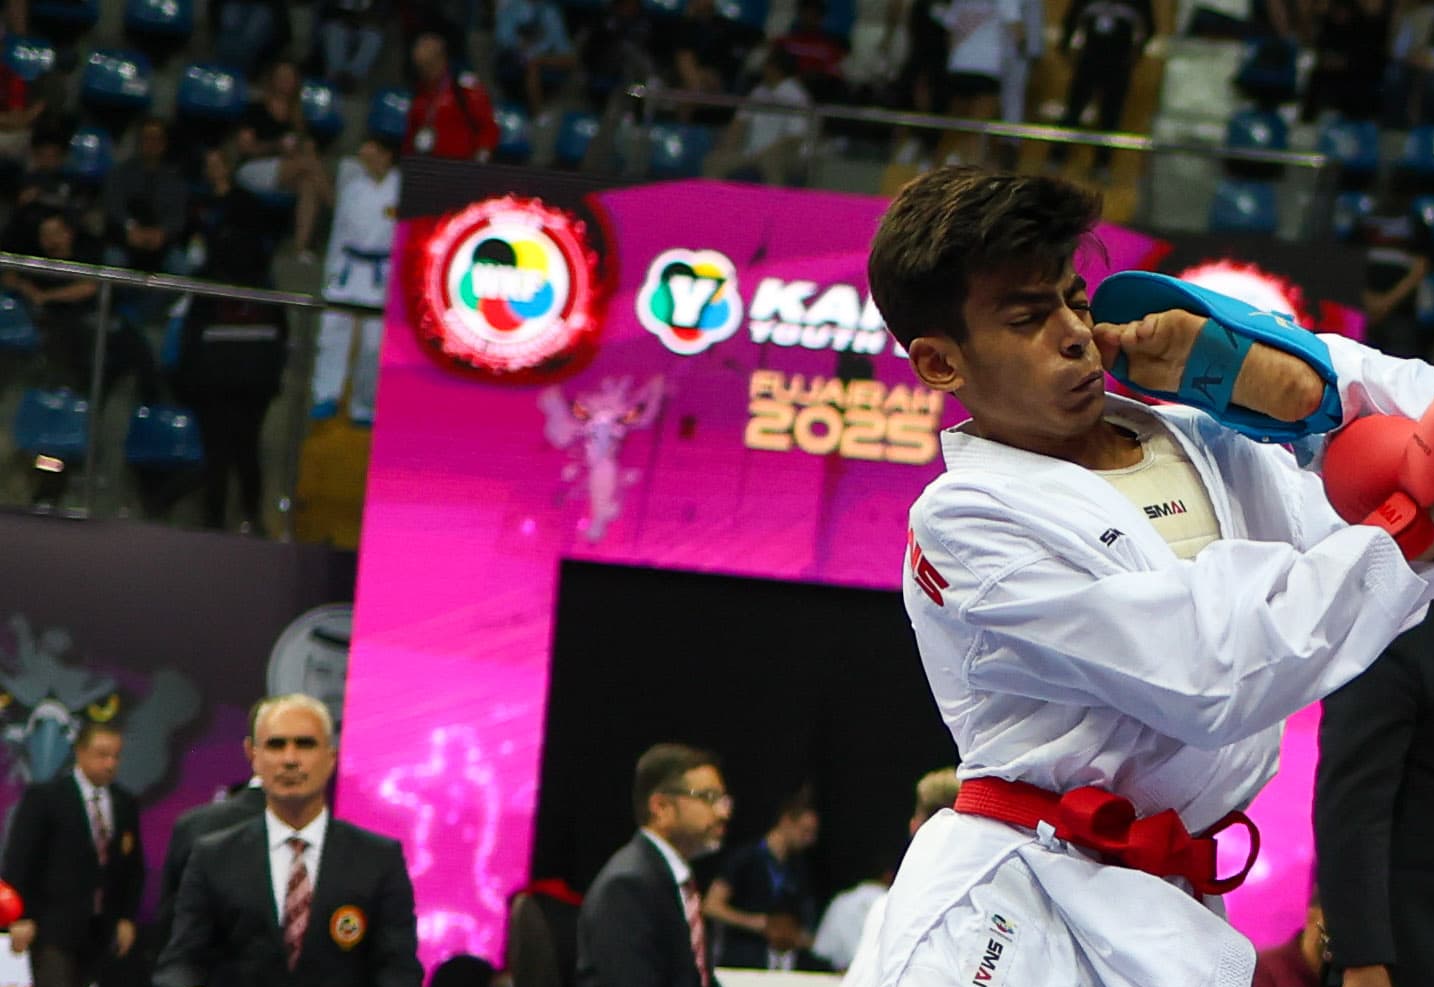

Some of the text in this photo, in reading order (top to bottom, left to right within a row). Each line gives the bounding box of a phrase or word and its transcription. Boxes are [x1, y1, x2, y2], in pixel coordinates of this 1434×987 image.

[748, 319, 888, 356] YOUTH
[750, 369, 944, 417] FUJAIRAH
[744, 399, 940, 466] 2025
[1143, 499, 1188, 520] SMAI
